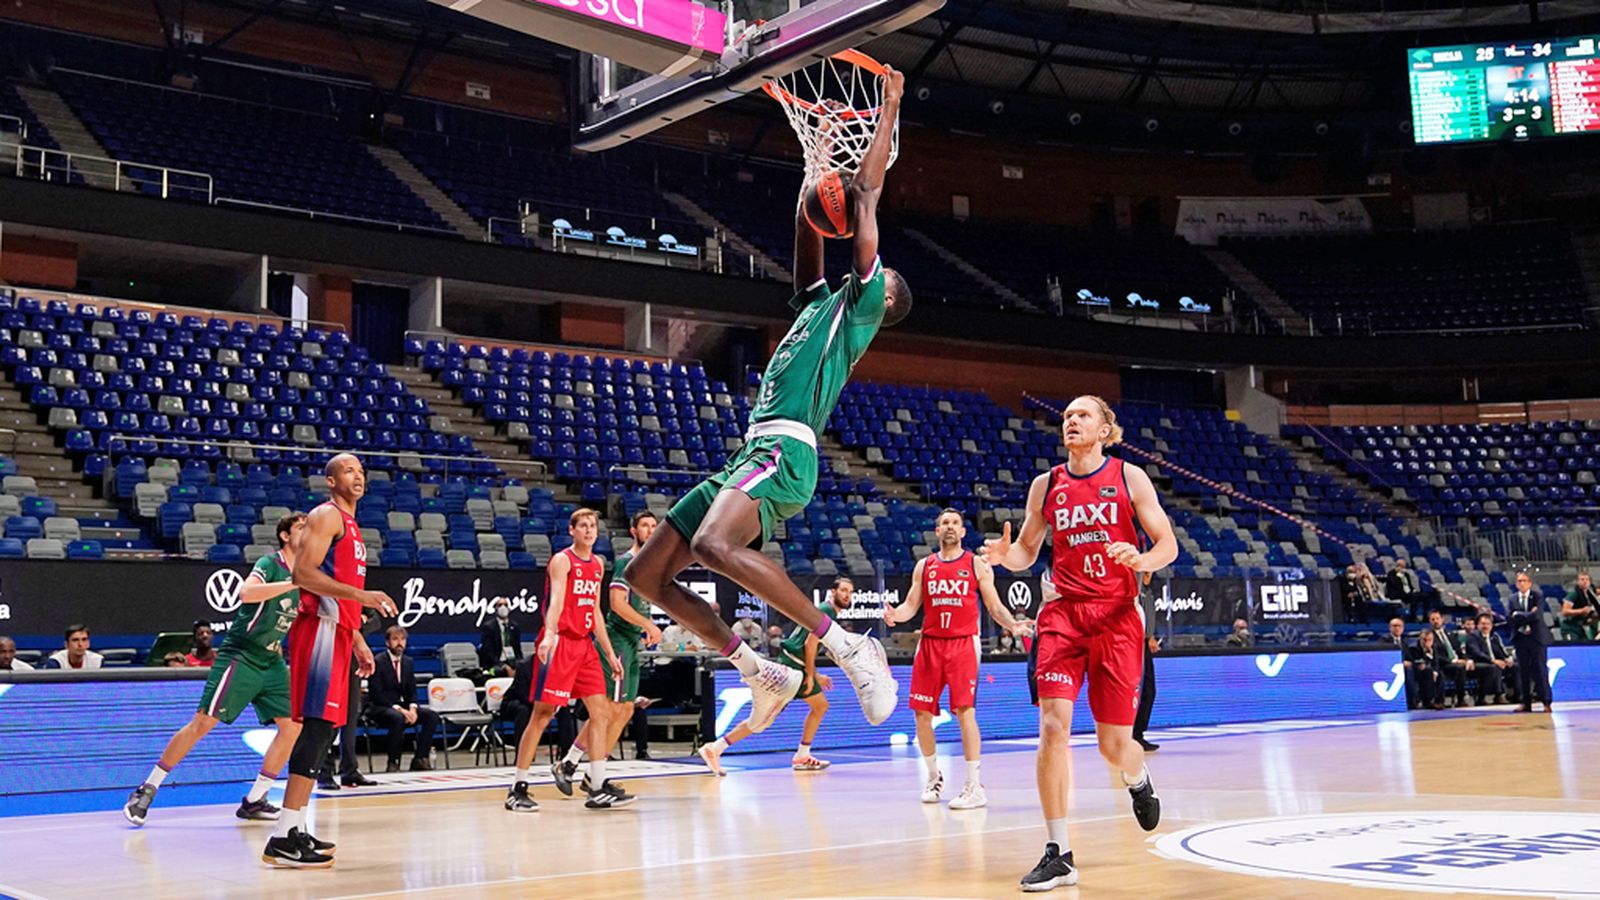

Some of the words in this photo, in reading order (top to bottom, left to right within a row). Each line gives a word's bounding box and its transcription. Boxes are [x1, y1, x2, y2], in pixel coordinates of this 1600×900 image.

[1475, 47, 1495, 62] 25
[1532, 42, 1552, 57] 34
[1504, 88, 1540, 104] 4:14
[1502, 107, 1513, 122] 3
[1531, 105, 1542, 120] 3
[1054, 502, 1118, 532] BAXI
[1083, 553, 1106, 578] 43
[573, 578, 600, 597] BAX
[927, 579, 969, 596] BAXI
[584, 612, 593, 629] 5
[940, 611, 952, 629] 17
[1331, 828, 1600, 877] PEDRIZ
